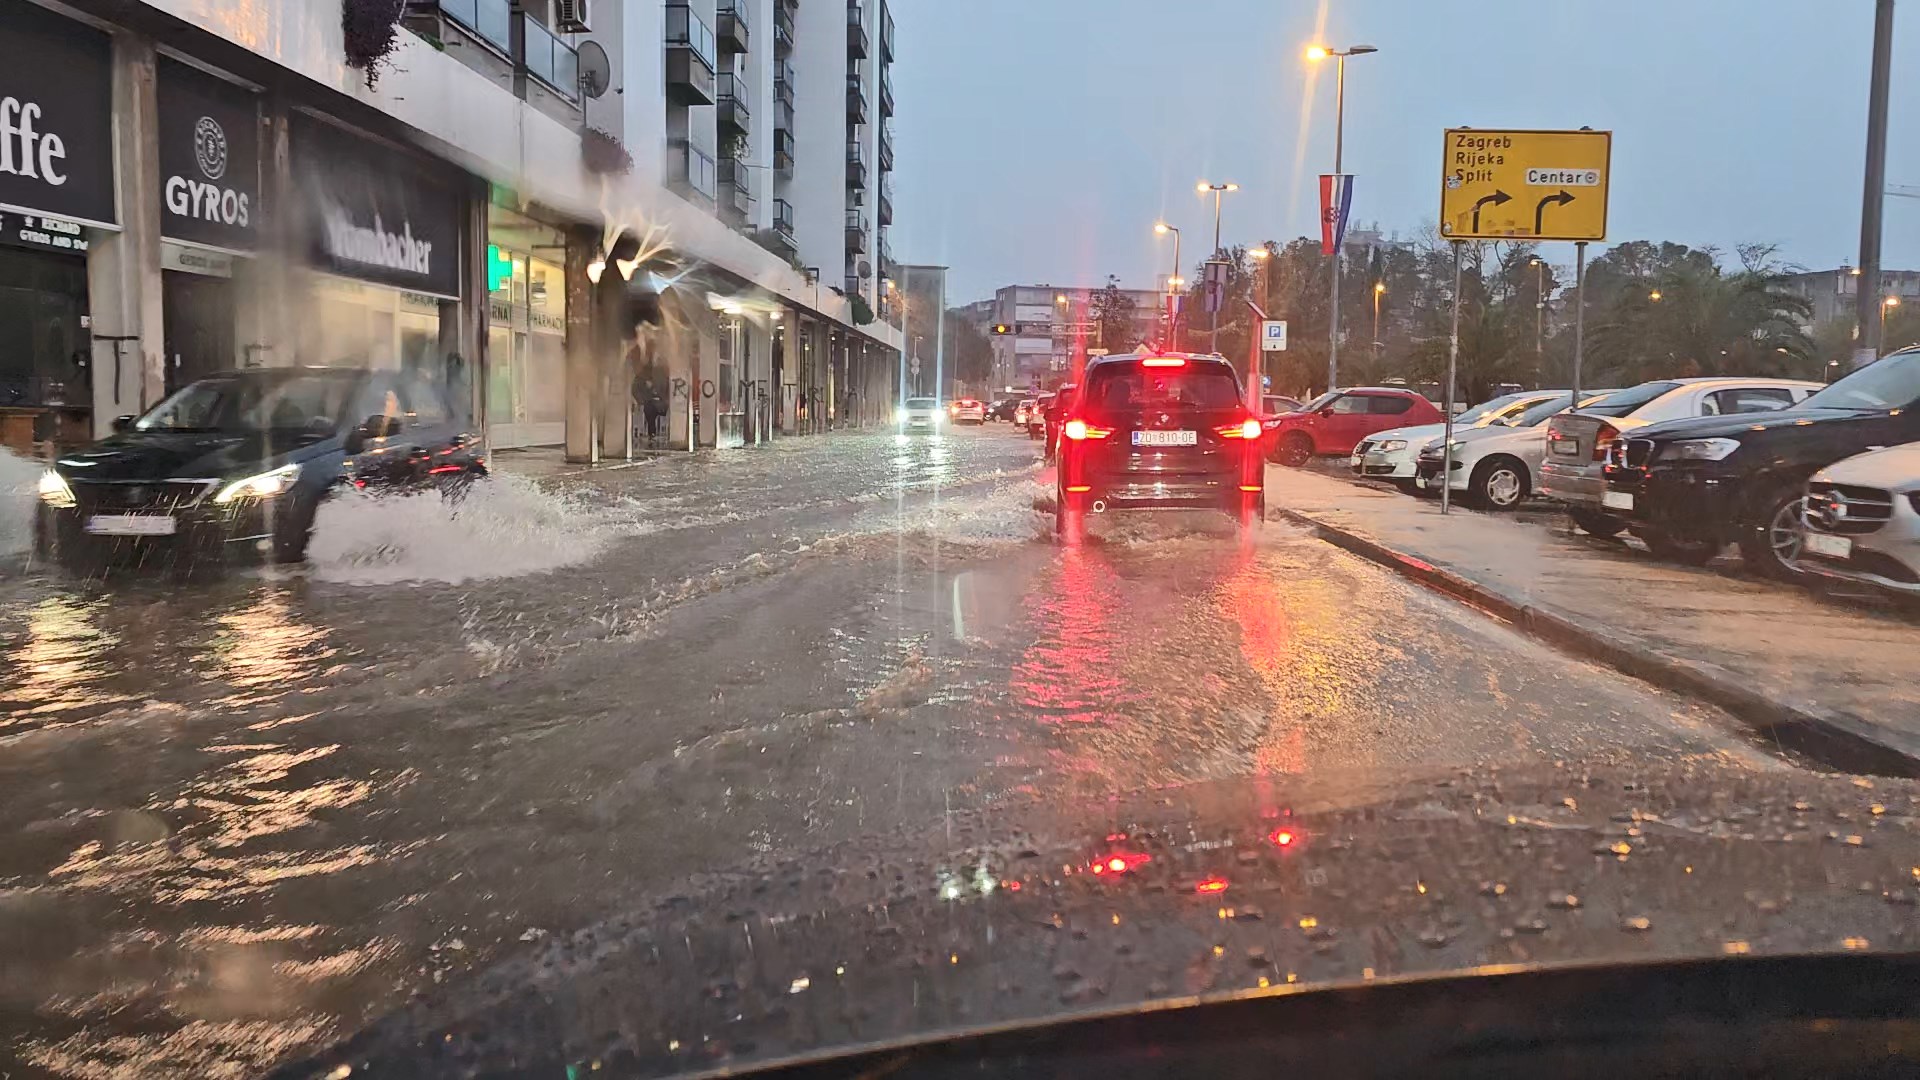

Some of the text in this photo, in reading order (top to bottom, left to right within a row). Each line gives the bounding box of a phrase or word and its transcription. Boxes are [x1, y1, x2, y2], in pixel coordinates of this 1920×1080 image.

[1456, 134, 1512, 151] Zagreb
[1455, 151, 1504, 167] Rijeka
[1455, 168, 1493, 184] Split
[1528, 169, 1581, 184] Centar
[165, 175, 249, 228] GYROS
